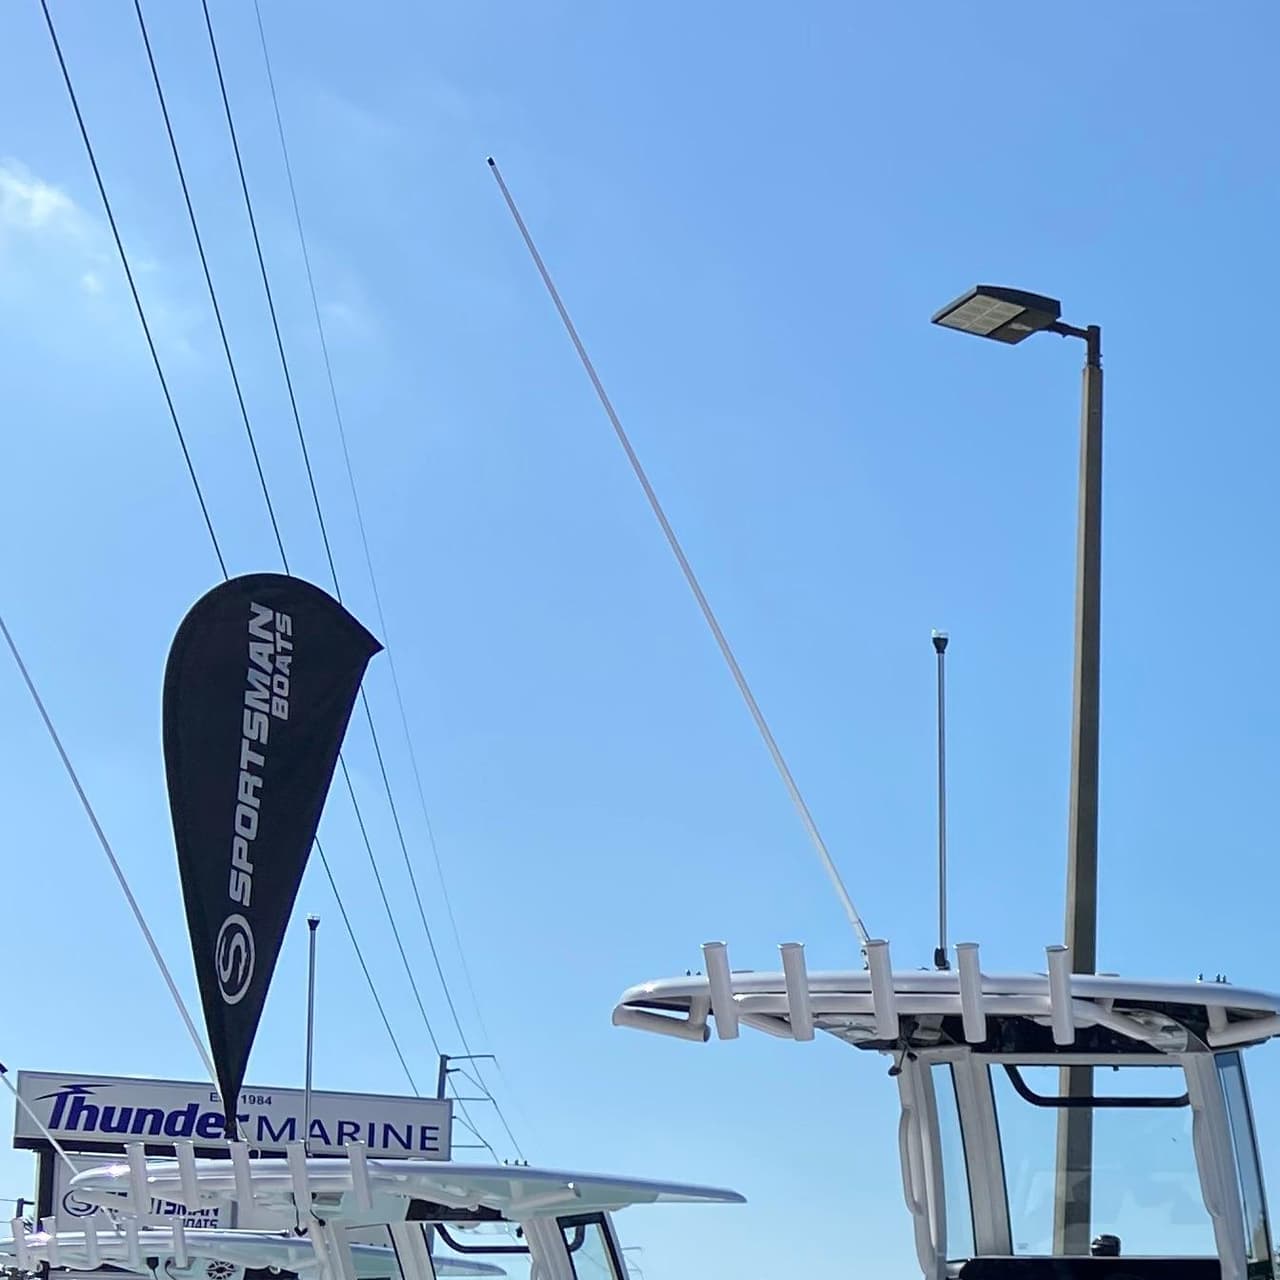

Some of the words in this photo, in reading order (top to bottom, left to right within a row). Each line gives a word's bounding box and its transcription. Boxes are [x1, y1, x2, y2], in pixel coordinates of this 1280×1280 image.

[271, 611, 293, 721] BOATS
[228, 601, 275, 907] SPORTSMAN
[240, 1094, 273, 1105] 1984
[257, 1115, 440, 1152] MARINE
